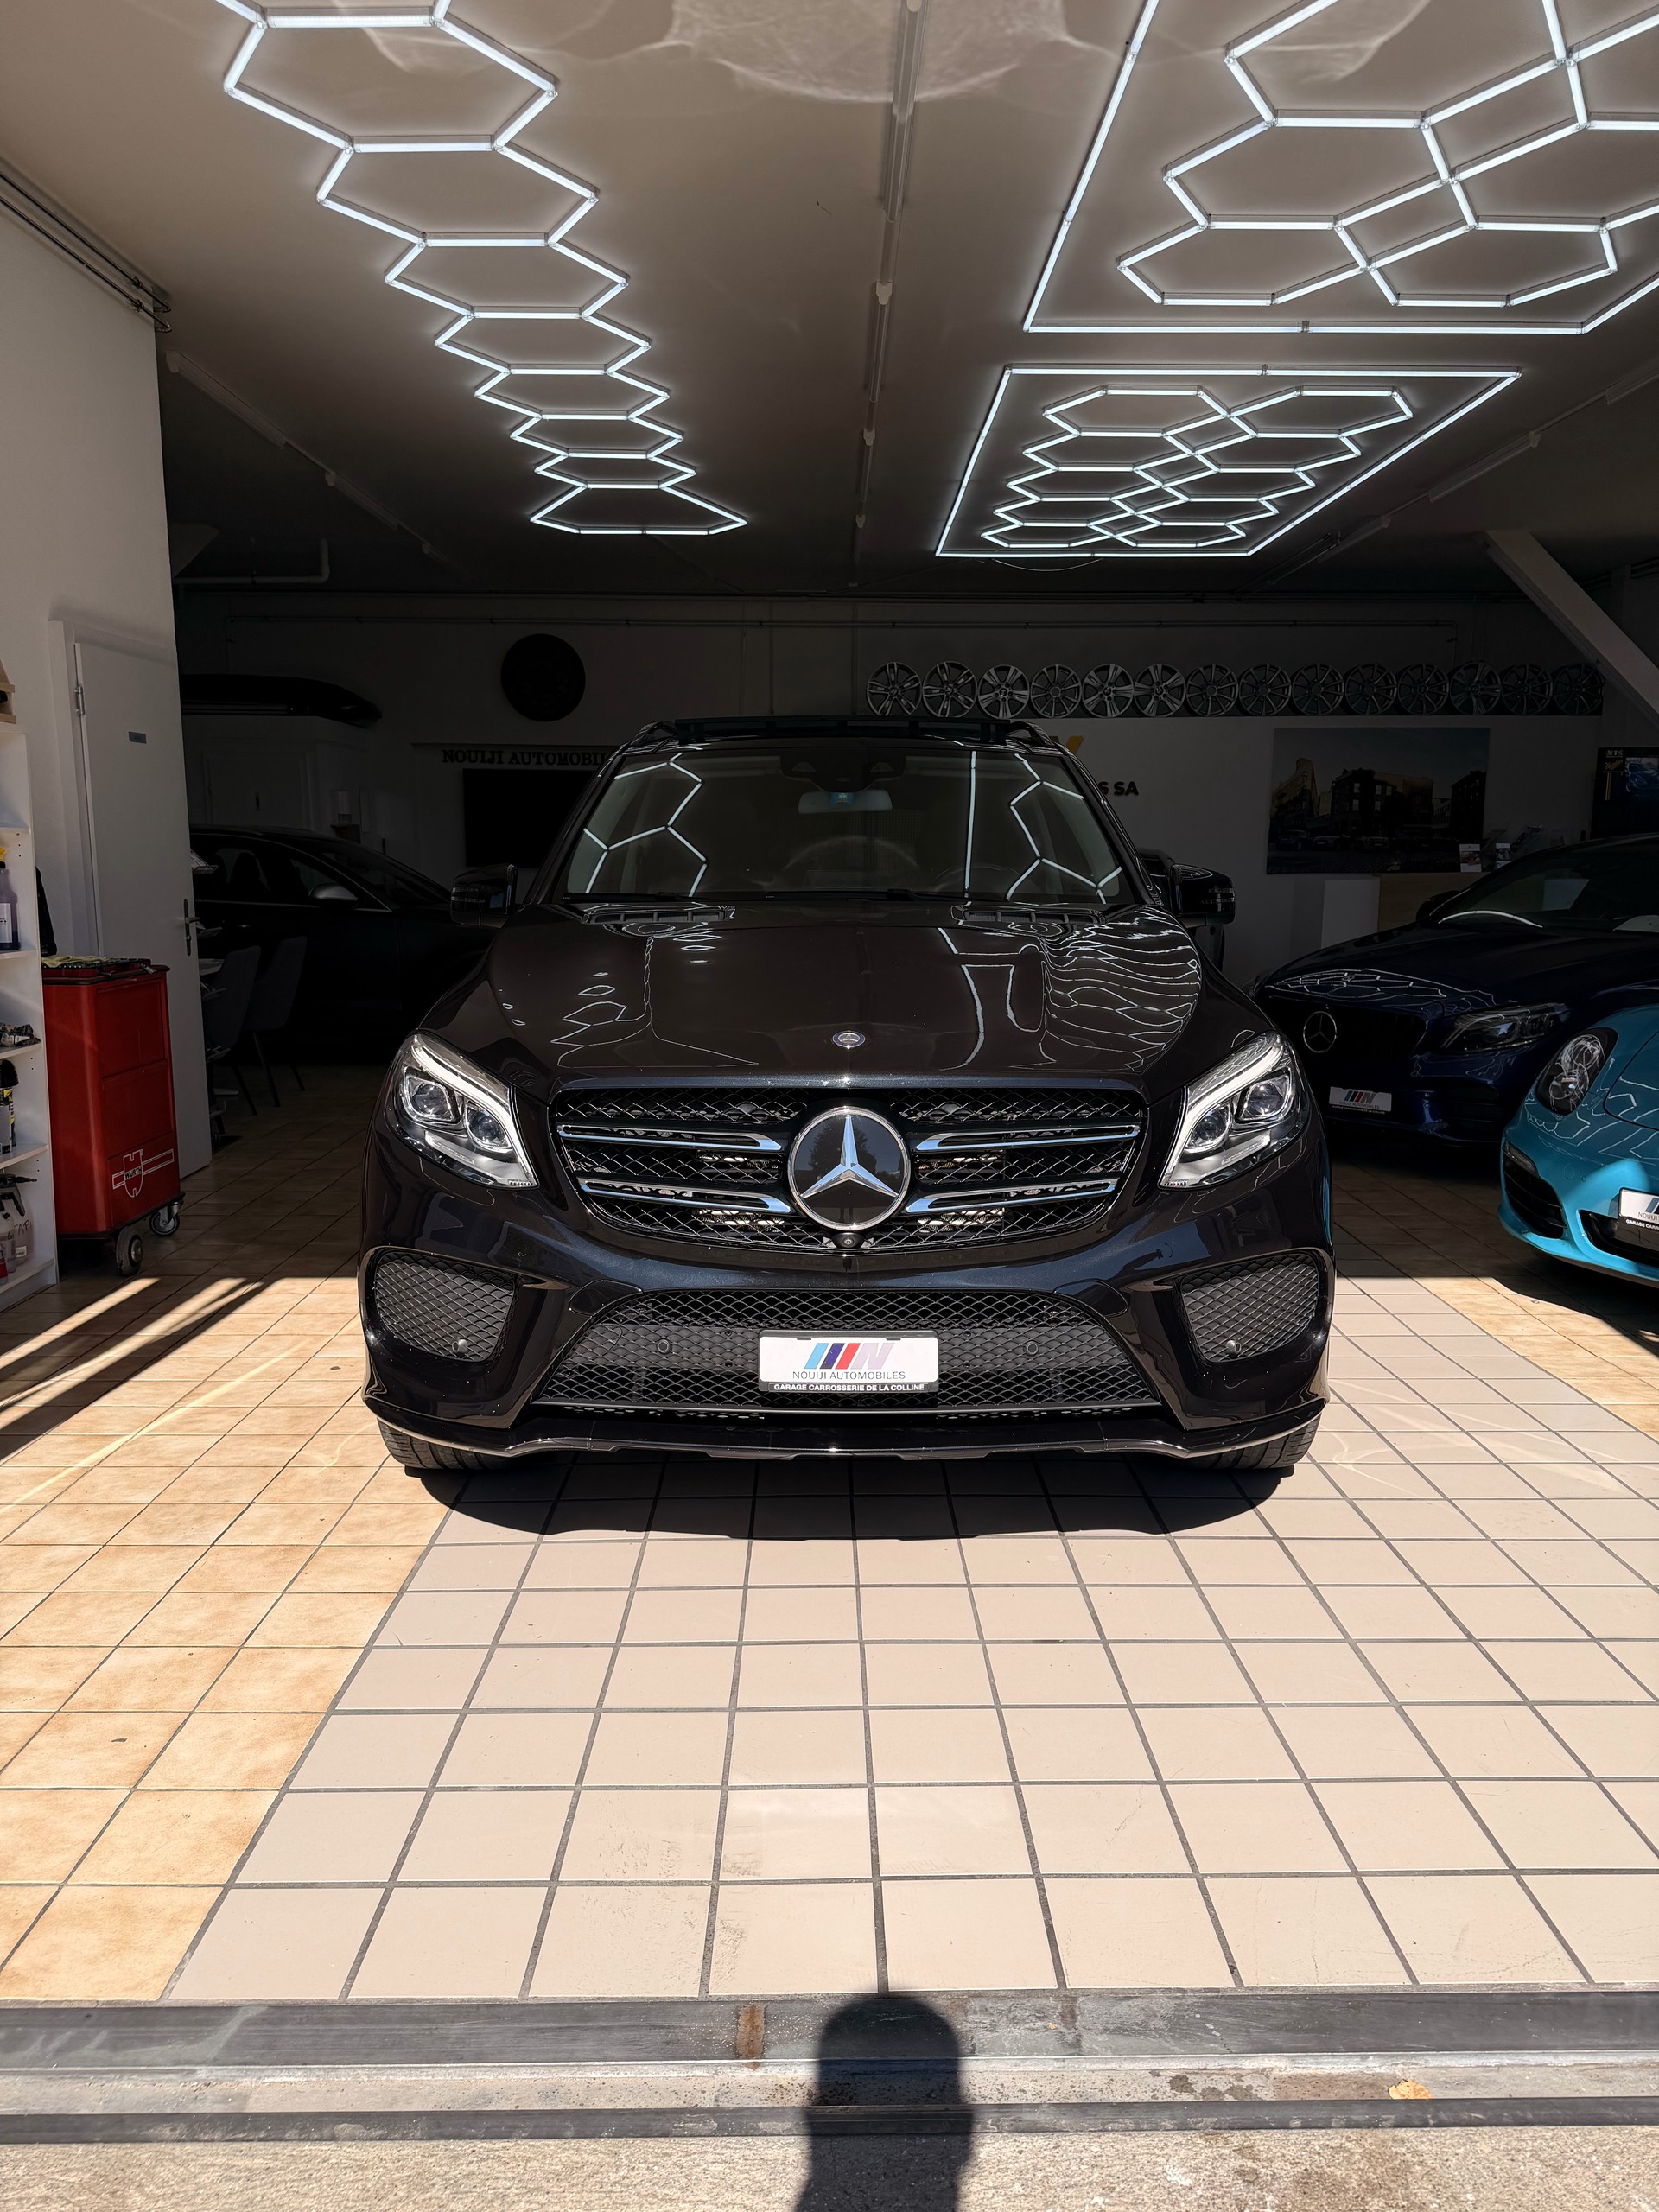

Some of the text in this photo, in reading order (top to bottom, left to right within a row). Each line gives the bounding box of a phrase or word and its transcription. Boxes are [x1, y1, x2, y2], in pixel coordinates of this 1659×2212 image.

[442, 749, 504, 765] NOUIJI
[1114, 781, 1139, 796] SA
[792, 1370, 906, 1380] NOUIJI AUTOMOBILES
